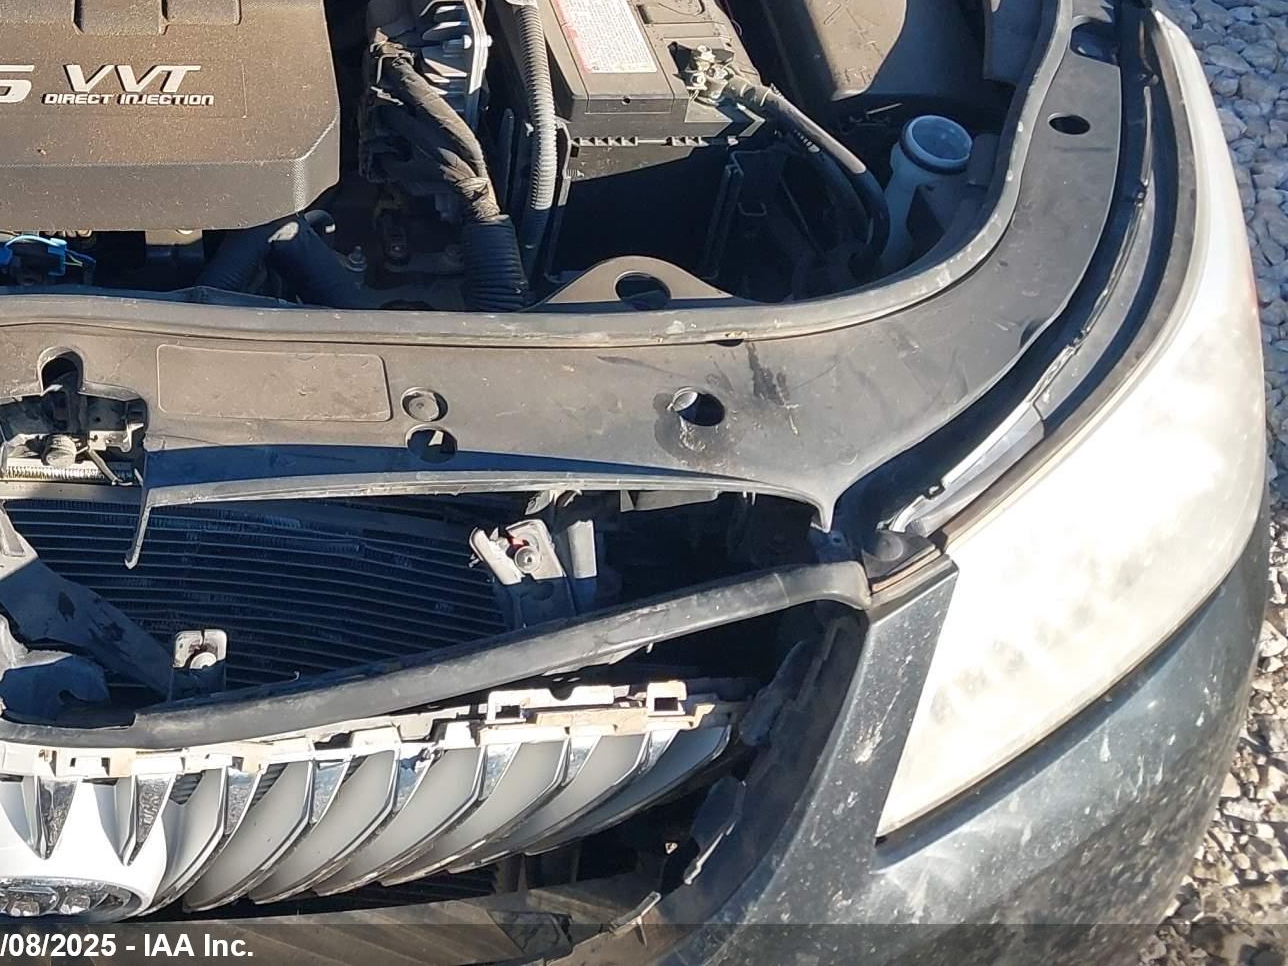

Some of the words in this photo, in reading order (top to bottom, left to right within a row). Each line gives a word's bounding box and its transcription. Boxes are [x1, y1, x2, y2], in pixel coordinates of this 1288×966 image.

[64, 64, 202, 94] VVT
[43, 93, 113, 106] DIRECT
[119, 93, 215, 107] INJECTION
